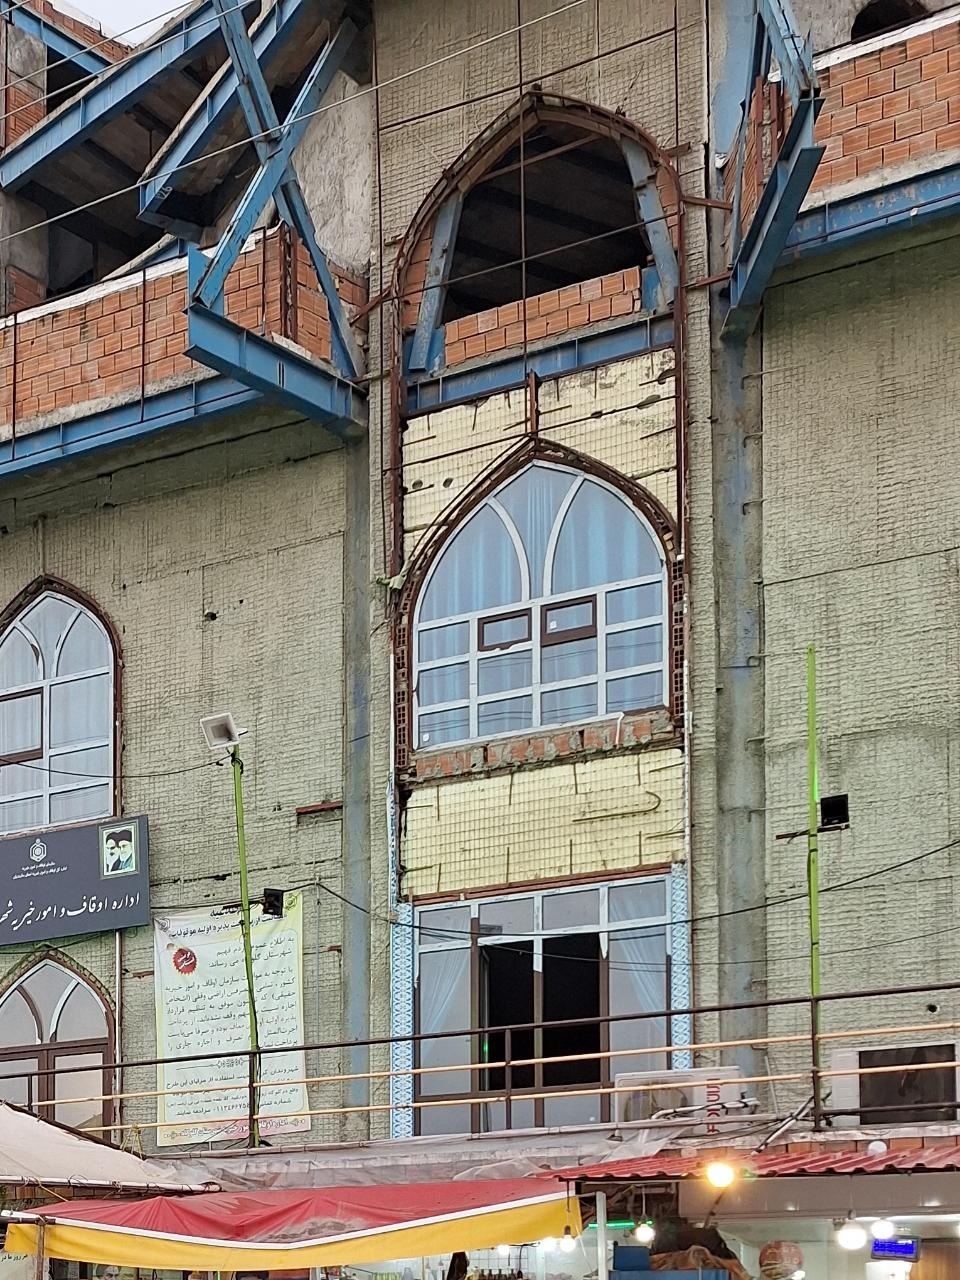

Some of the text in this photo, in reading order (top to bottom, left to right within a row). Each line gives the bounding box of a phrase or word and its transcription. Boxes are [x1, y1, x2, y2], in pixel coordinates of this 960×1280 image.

[67, 896, 108, 916] اوقاف
[111, 892, 140, 910] اداره
[11, 901, 35, 931] خیریه
[35, 905, 57, 921] امور
[60, 908, 66, 918] و
